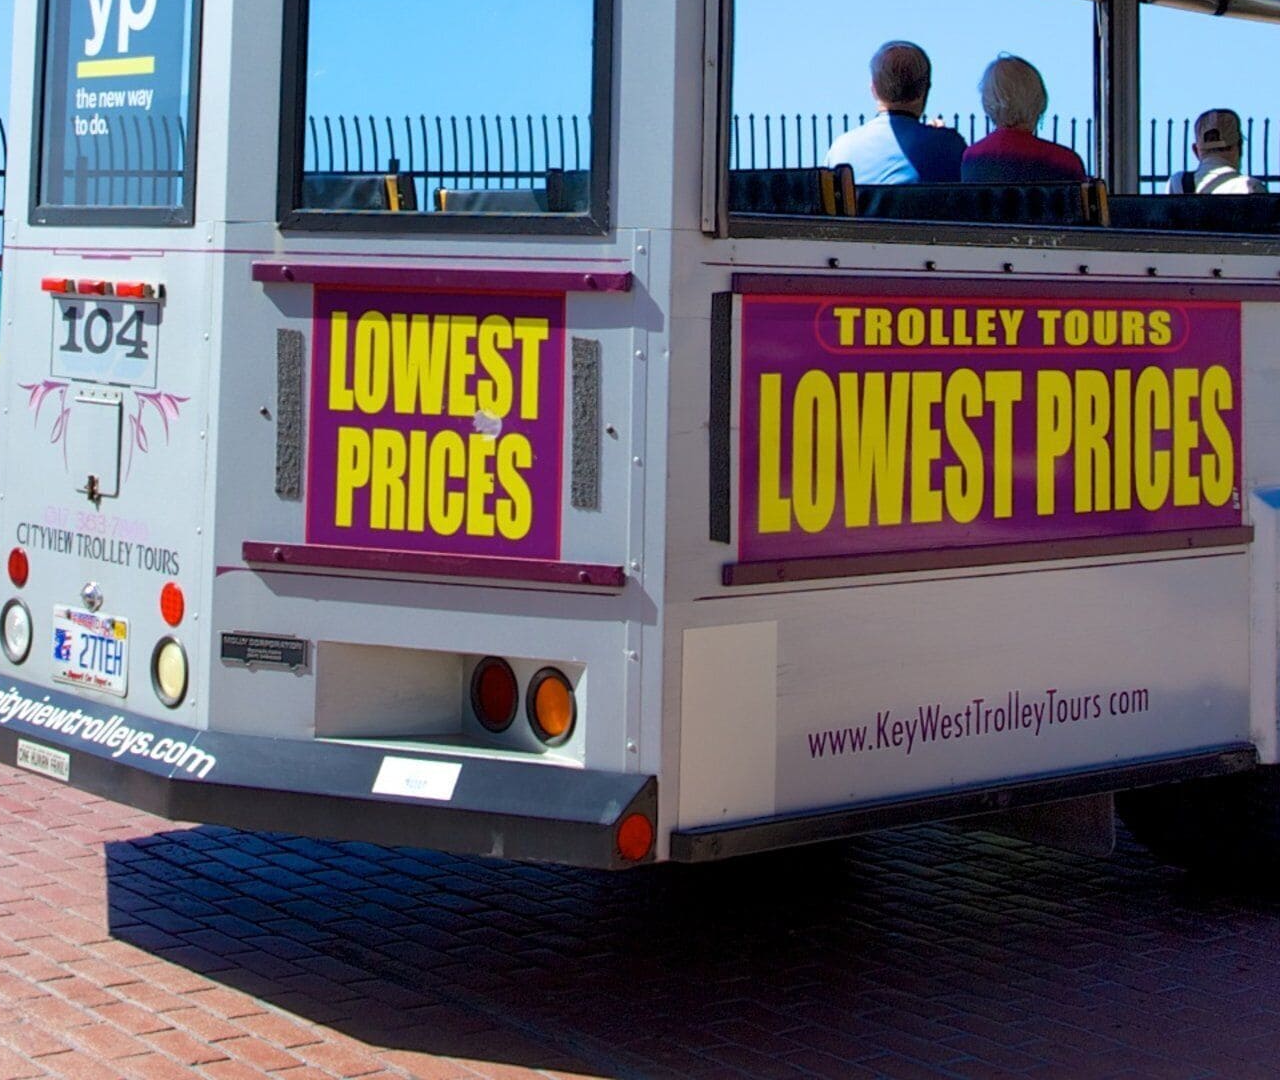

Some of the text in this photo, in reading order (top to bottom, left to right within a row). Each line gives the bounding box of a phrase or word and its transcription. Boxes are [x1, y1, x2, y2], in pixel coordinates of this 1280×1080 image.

[75, 113, 110, 136] to do.
[76, 87, 154, 111] the new way
[61, 306, 148, 359] 104
[833, 306, 1173, 347] TROLLEY TOURS
[328, 310, 549, 420] LOWEST
[757, 364, 1234, 534] LOWEST PRICES
[334, 426, 533, 540] PRICES
[16, 522, 180, 576] CITYVIEW TROLLEY TOURS
[79, 633, 123, 677] 27TEH
